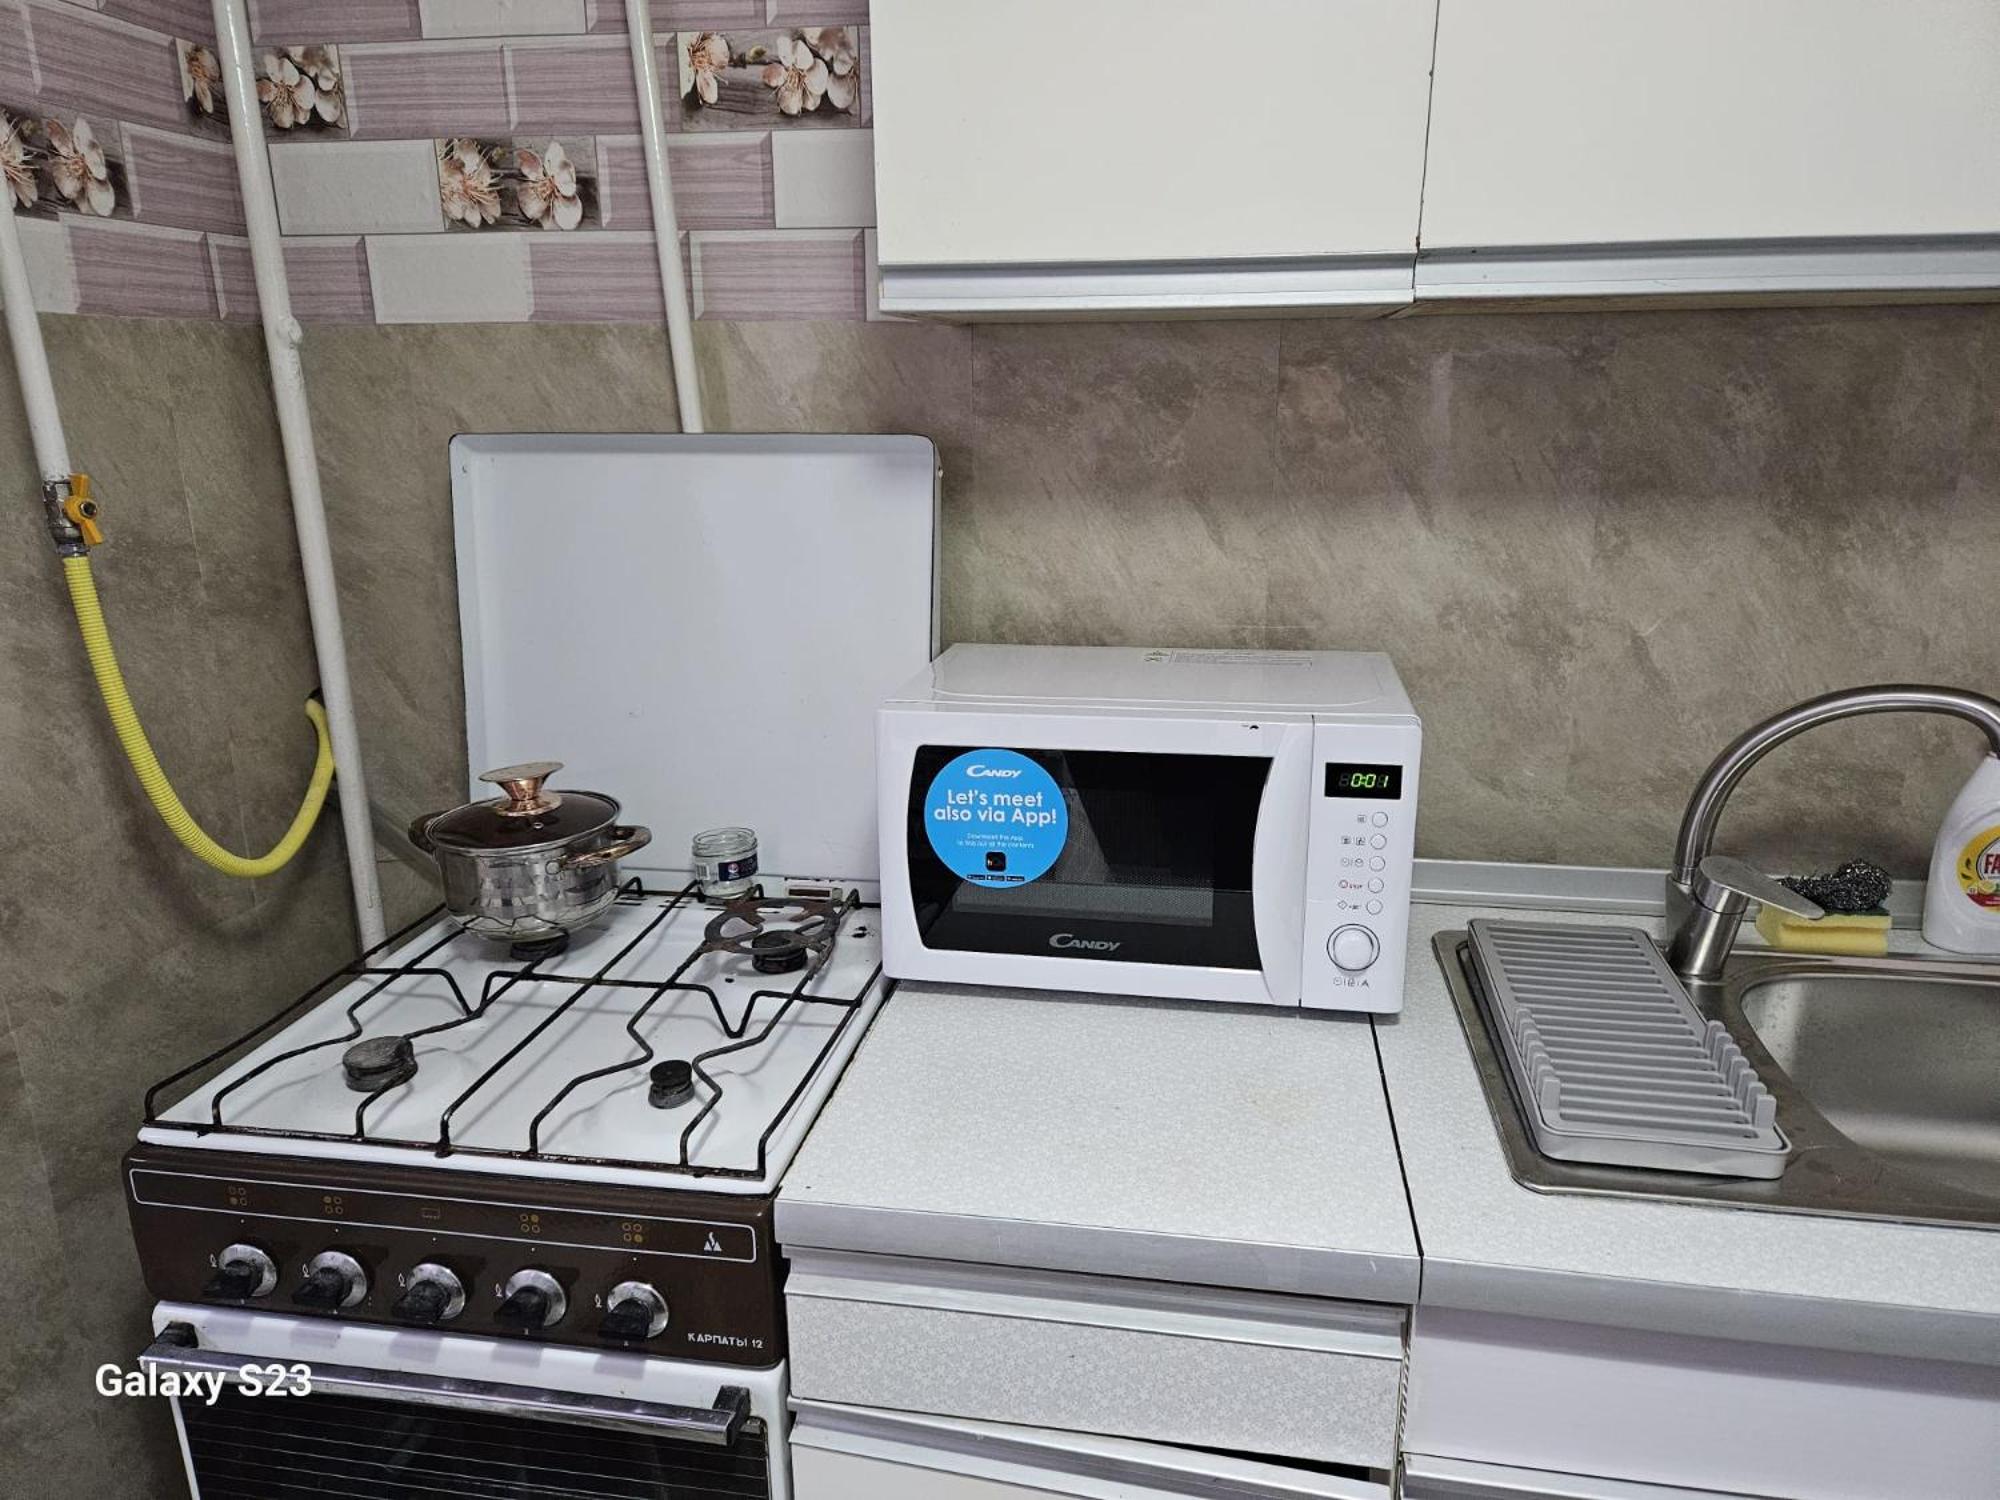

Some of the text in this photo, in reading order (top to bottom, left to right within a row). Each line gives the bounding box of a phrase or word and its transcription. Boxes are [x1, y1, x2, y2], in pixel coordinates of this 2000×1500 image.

[1350, 773, 1389, 788] 0:01
[993, 792, 1043, 807] meet
[934, 805, 1057, 827] also via App!
[687, 1332, 764, 1349] КАРПАТЫ 12
